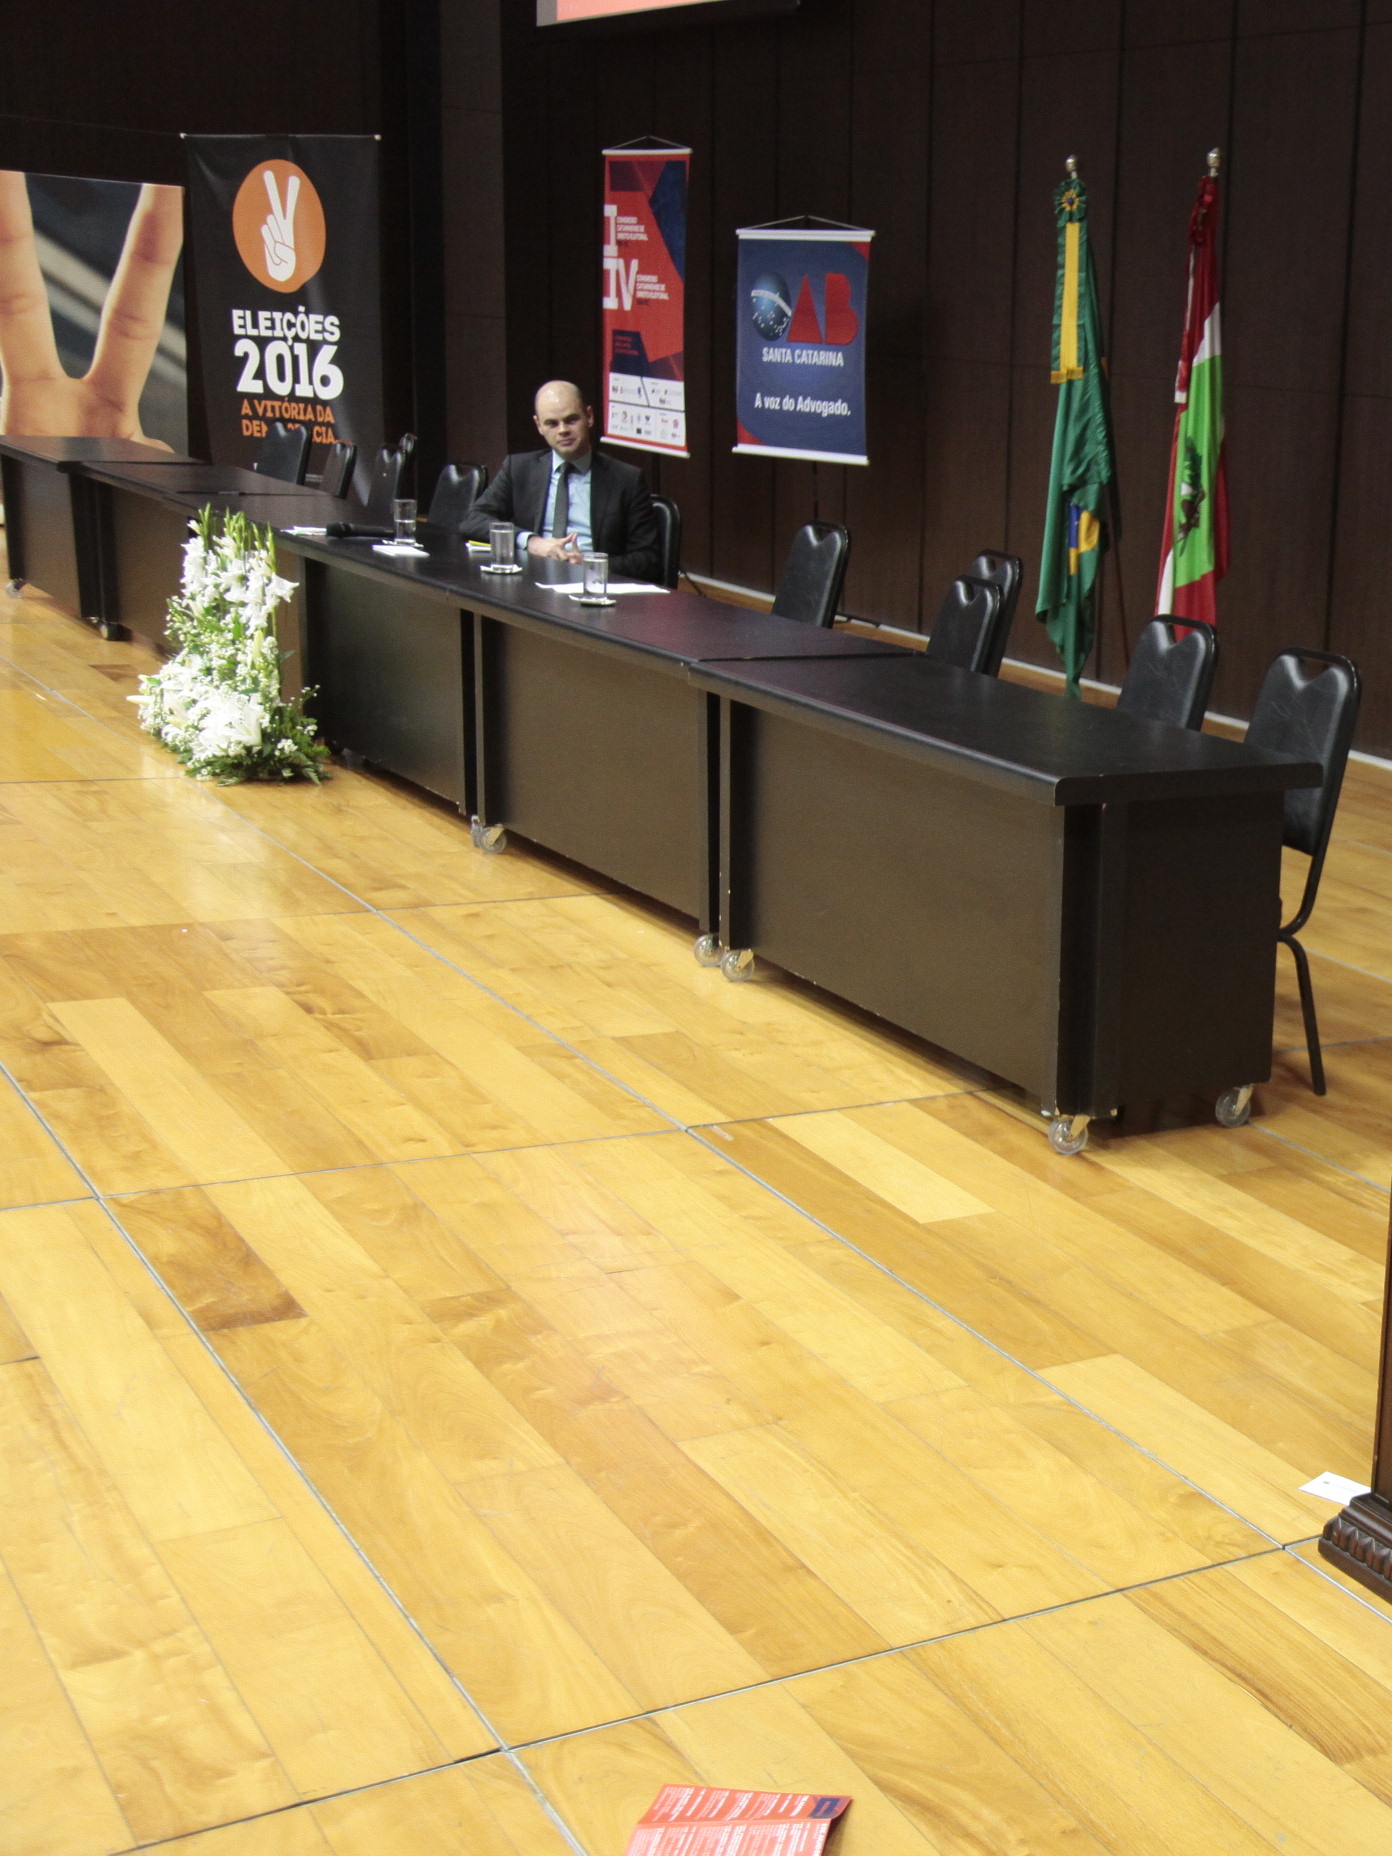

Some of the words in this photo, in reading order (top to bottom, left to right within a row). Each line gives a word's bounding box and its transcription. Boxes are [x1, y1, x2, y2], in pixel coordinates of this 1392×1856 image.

[231, 305, 341, 345] ELEIÇÕES
[233, 338, 344, 400] 2016
[762, 347, 792, 364] SANTA
[794, 349, 844, 367] CATARINA
[241, 398, 253, 416] A
[253, 396, 315, 421] VITÓRIA
[316, 404, 335, 424] DA
[754, 392, 763, 409] A
[764, 396, 780, 410] voz
[782, 394, 795, 411] do
[796, 395, 851, 418] Advogado.
